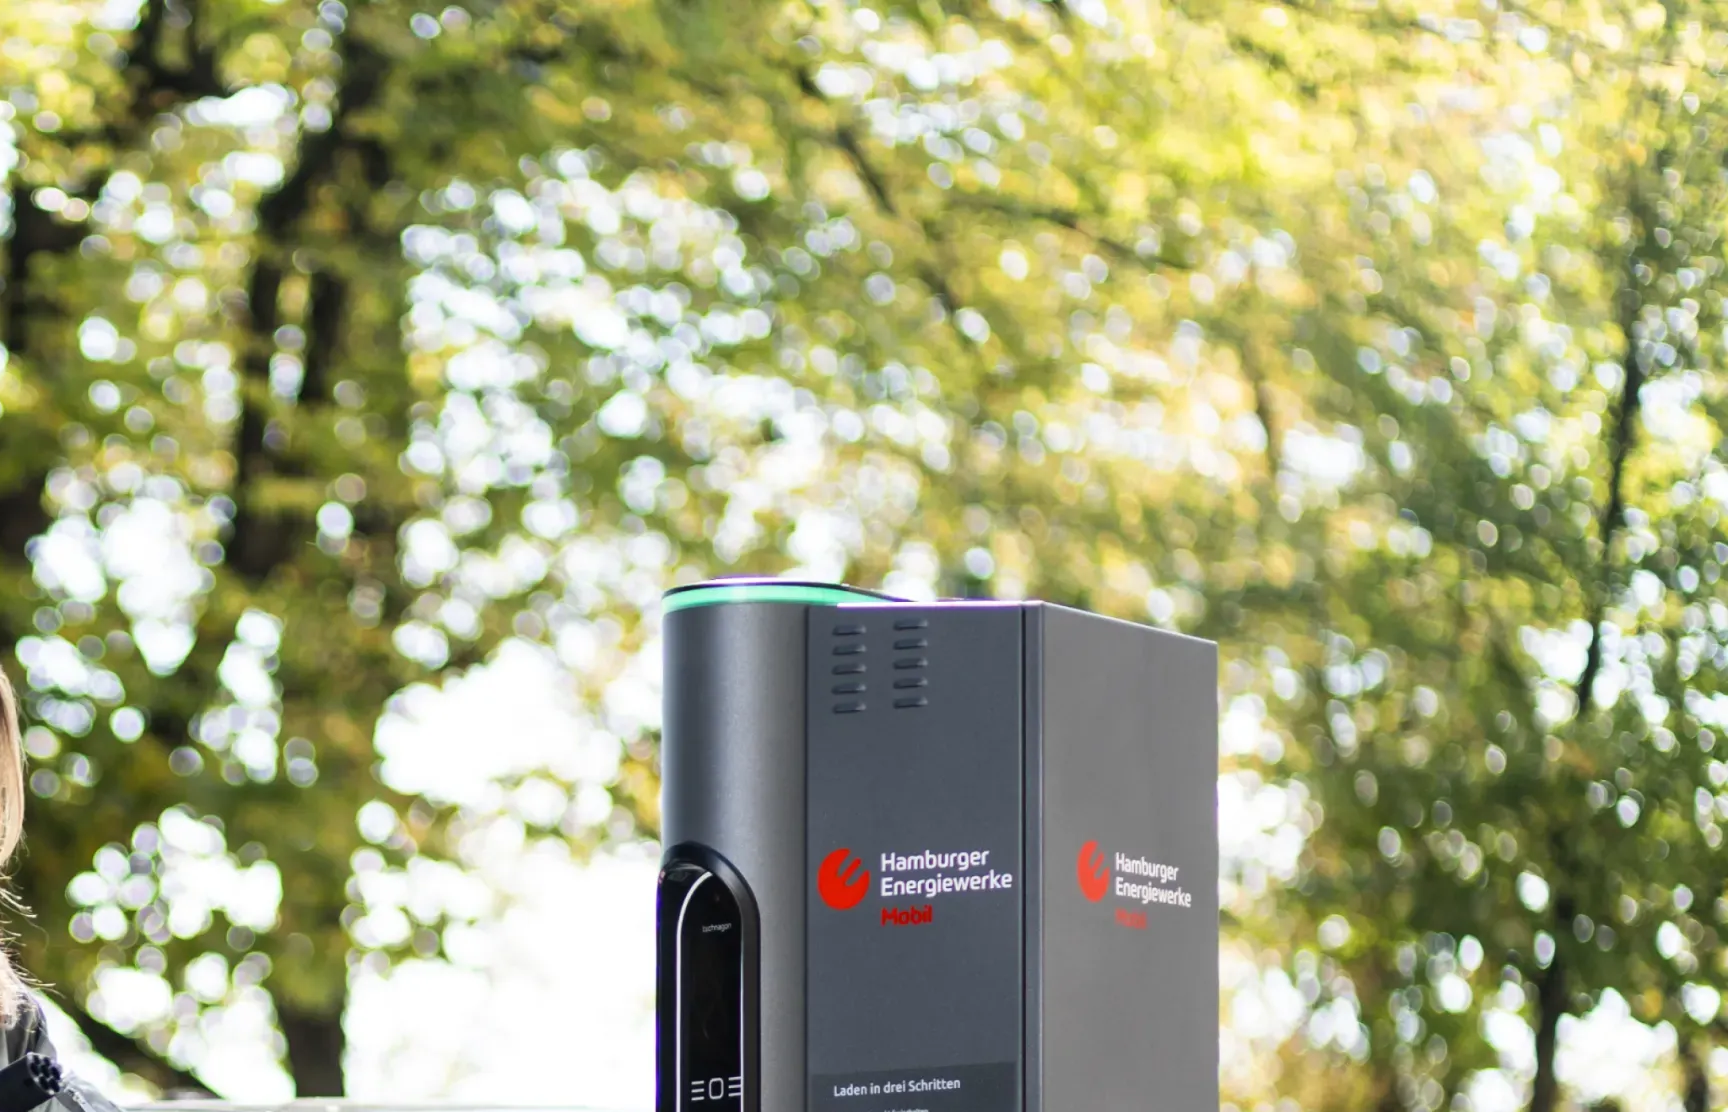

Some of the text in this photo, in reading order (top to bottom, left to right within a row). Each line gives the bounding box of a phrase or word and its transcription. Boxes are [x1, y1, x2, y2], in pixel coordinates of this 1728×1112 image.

[880, 849, 990, 872] Hamburger
[1115, 852, 1179, 883] Hamburger
[880, 869, 1013, 898] Energiewerke
[1115, 876, 1192, 908] Energiewerke
[880, 904, 933, 927] Mobil
[834, 1078, 960, 1097] Laden in drei Schritten
